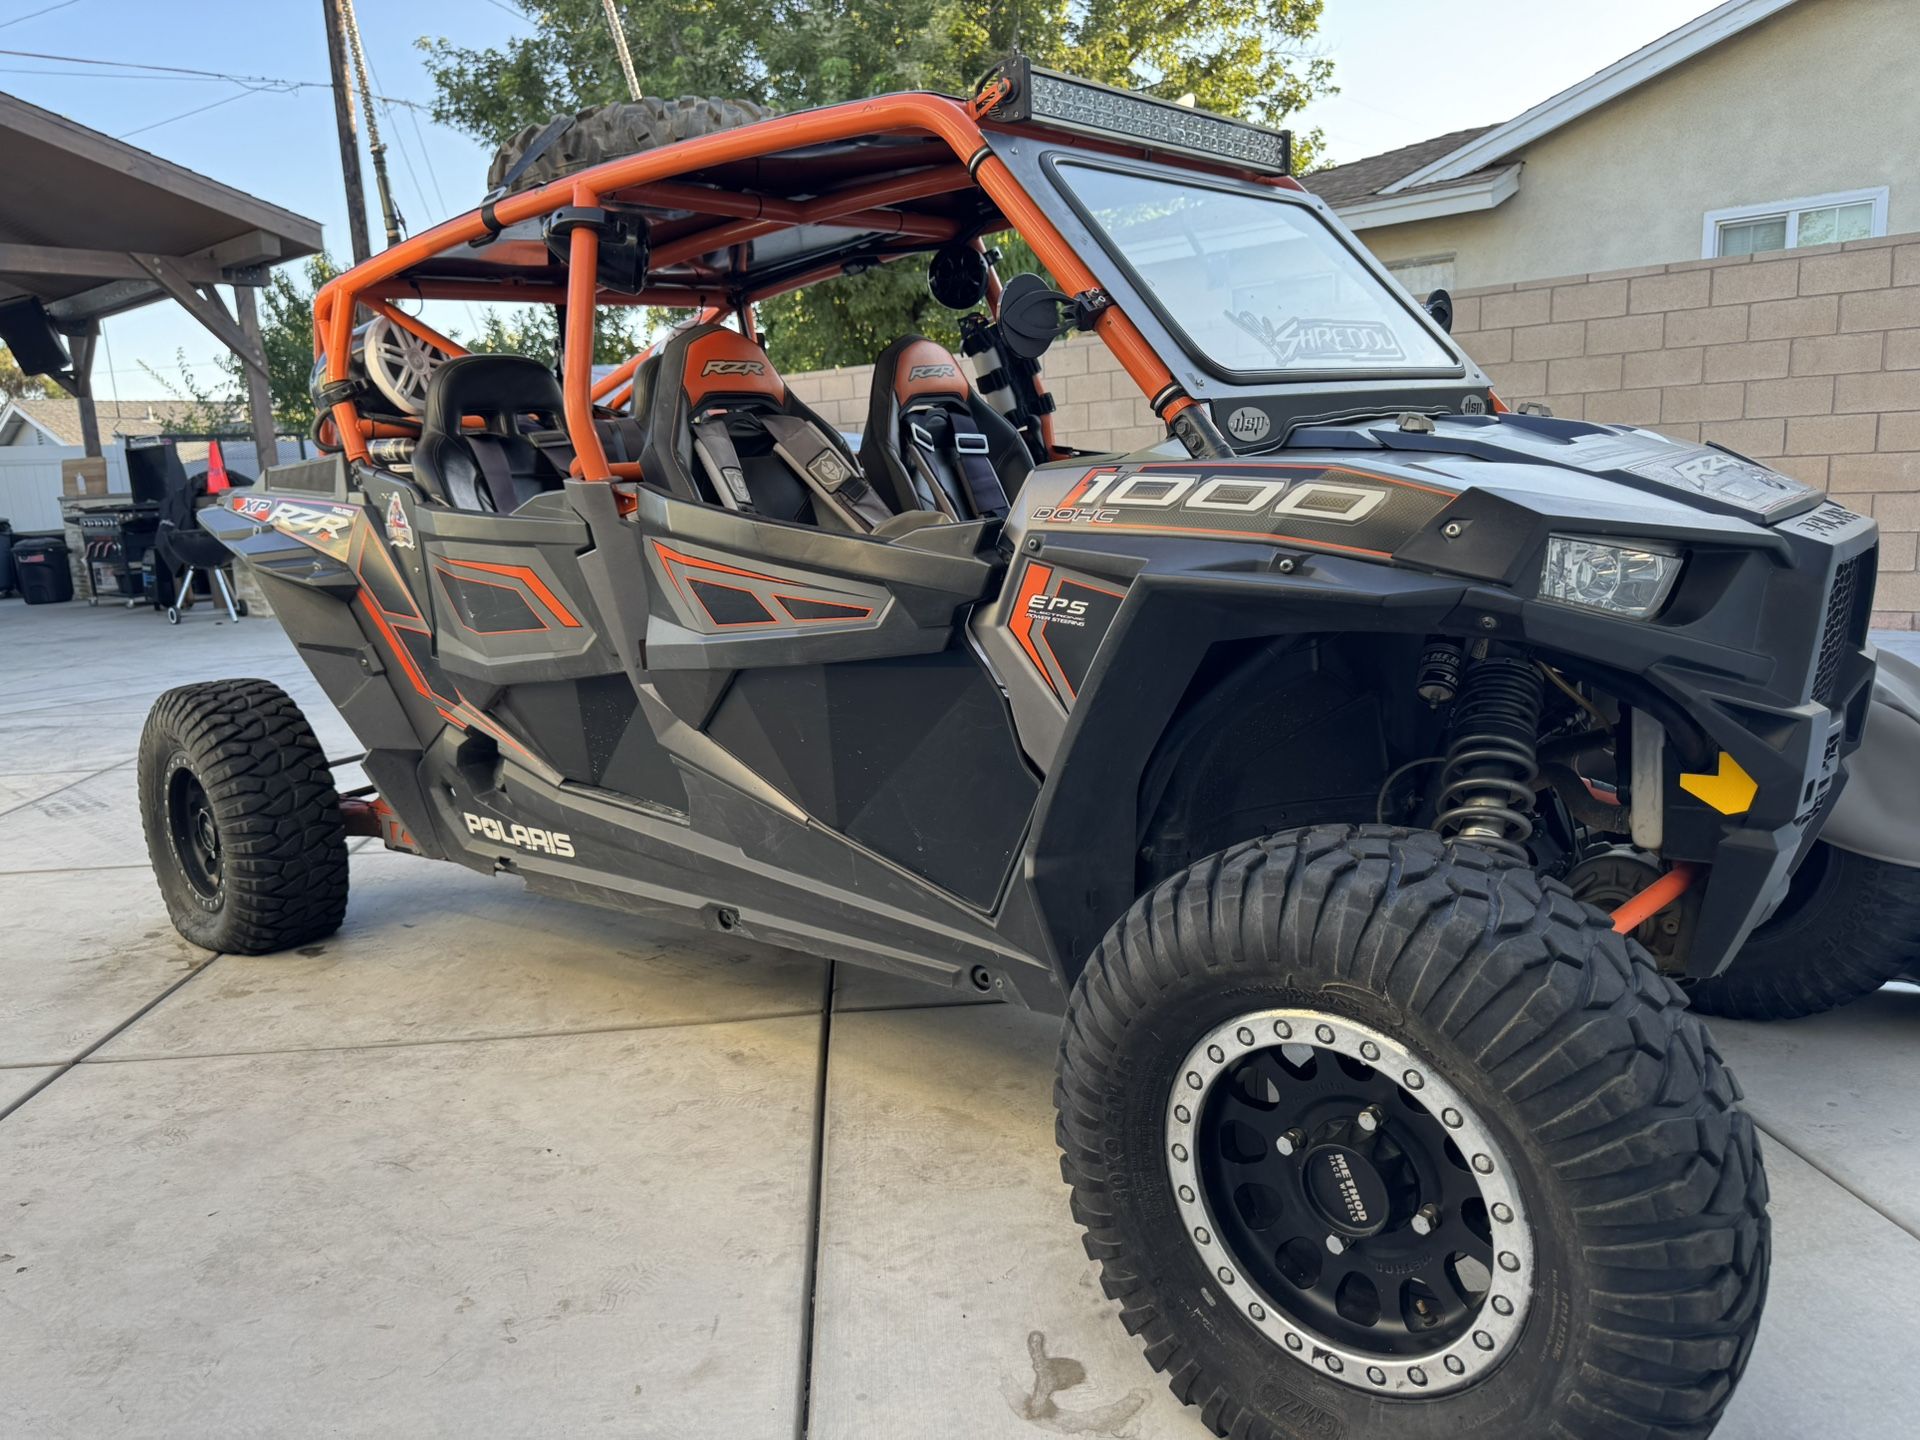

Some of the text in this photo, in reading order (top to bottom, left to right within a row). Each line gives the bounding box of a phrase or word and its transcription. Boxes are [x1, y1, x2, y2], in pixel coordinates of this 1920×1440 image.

[700, 360, 765, 377] RZR
[908, 364, 955, 382] RZR
[237, 498, 273, 514] XP
[1078, 473, 1389, 524] 1000
[266, 502, 349, 540] RZR
[1031, 506, 1120, 524] DOHC
[1028, 594, 1089, 615] EPS
[1025, 613, 1086, 627] POWER STEERING
[463, 811, 576, 858] POLARIS
[1327, 1154, 1360, 1222] RACE WHEELS
[1334, 1153, 1368, 1221] METHOD
